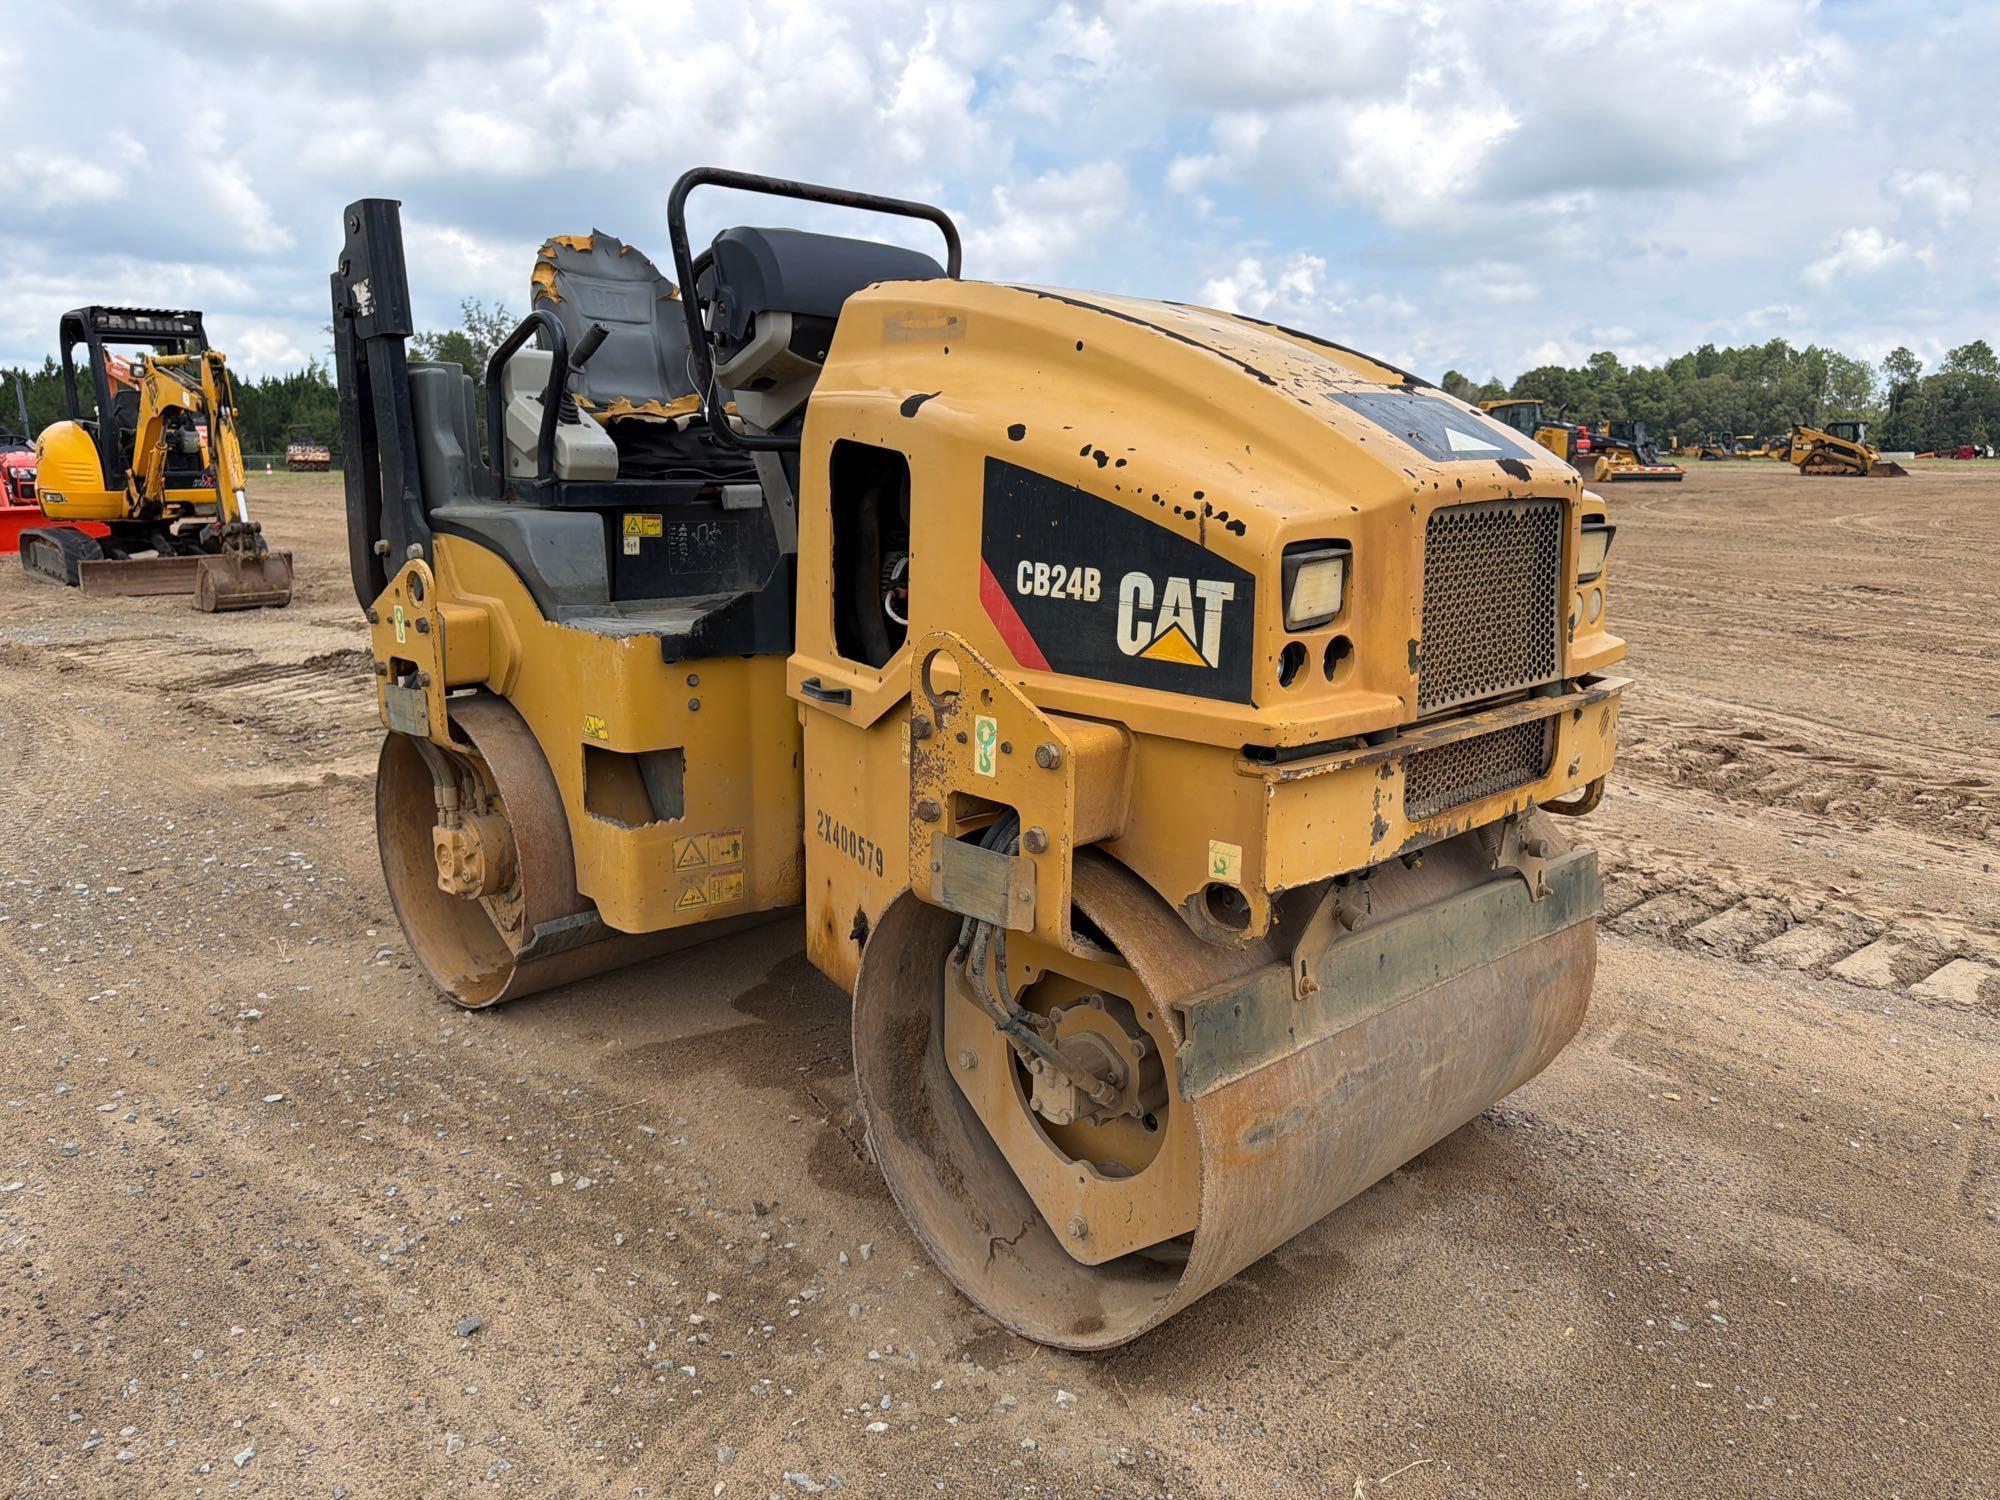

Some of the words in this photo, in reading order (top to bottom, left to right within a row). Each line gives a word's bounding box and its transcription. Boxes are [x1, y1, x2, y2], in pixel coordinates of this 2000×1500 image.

[1017, 560, 1101, 602] CB24B
[1117, 571, 1235, 669] CAT
[817, 808, 884, 878] 2X400579
